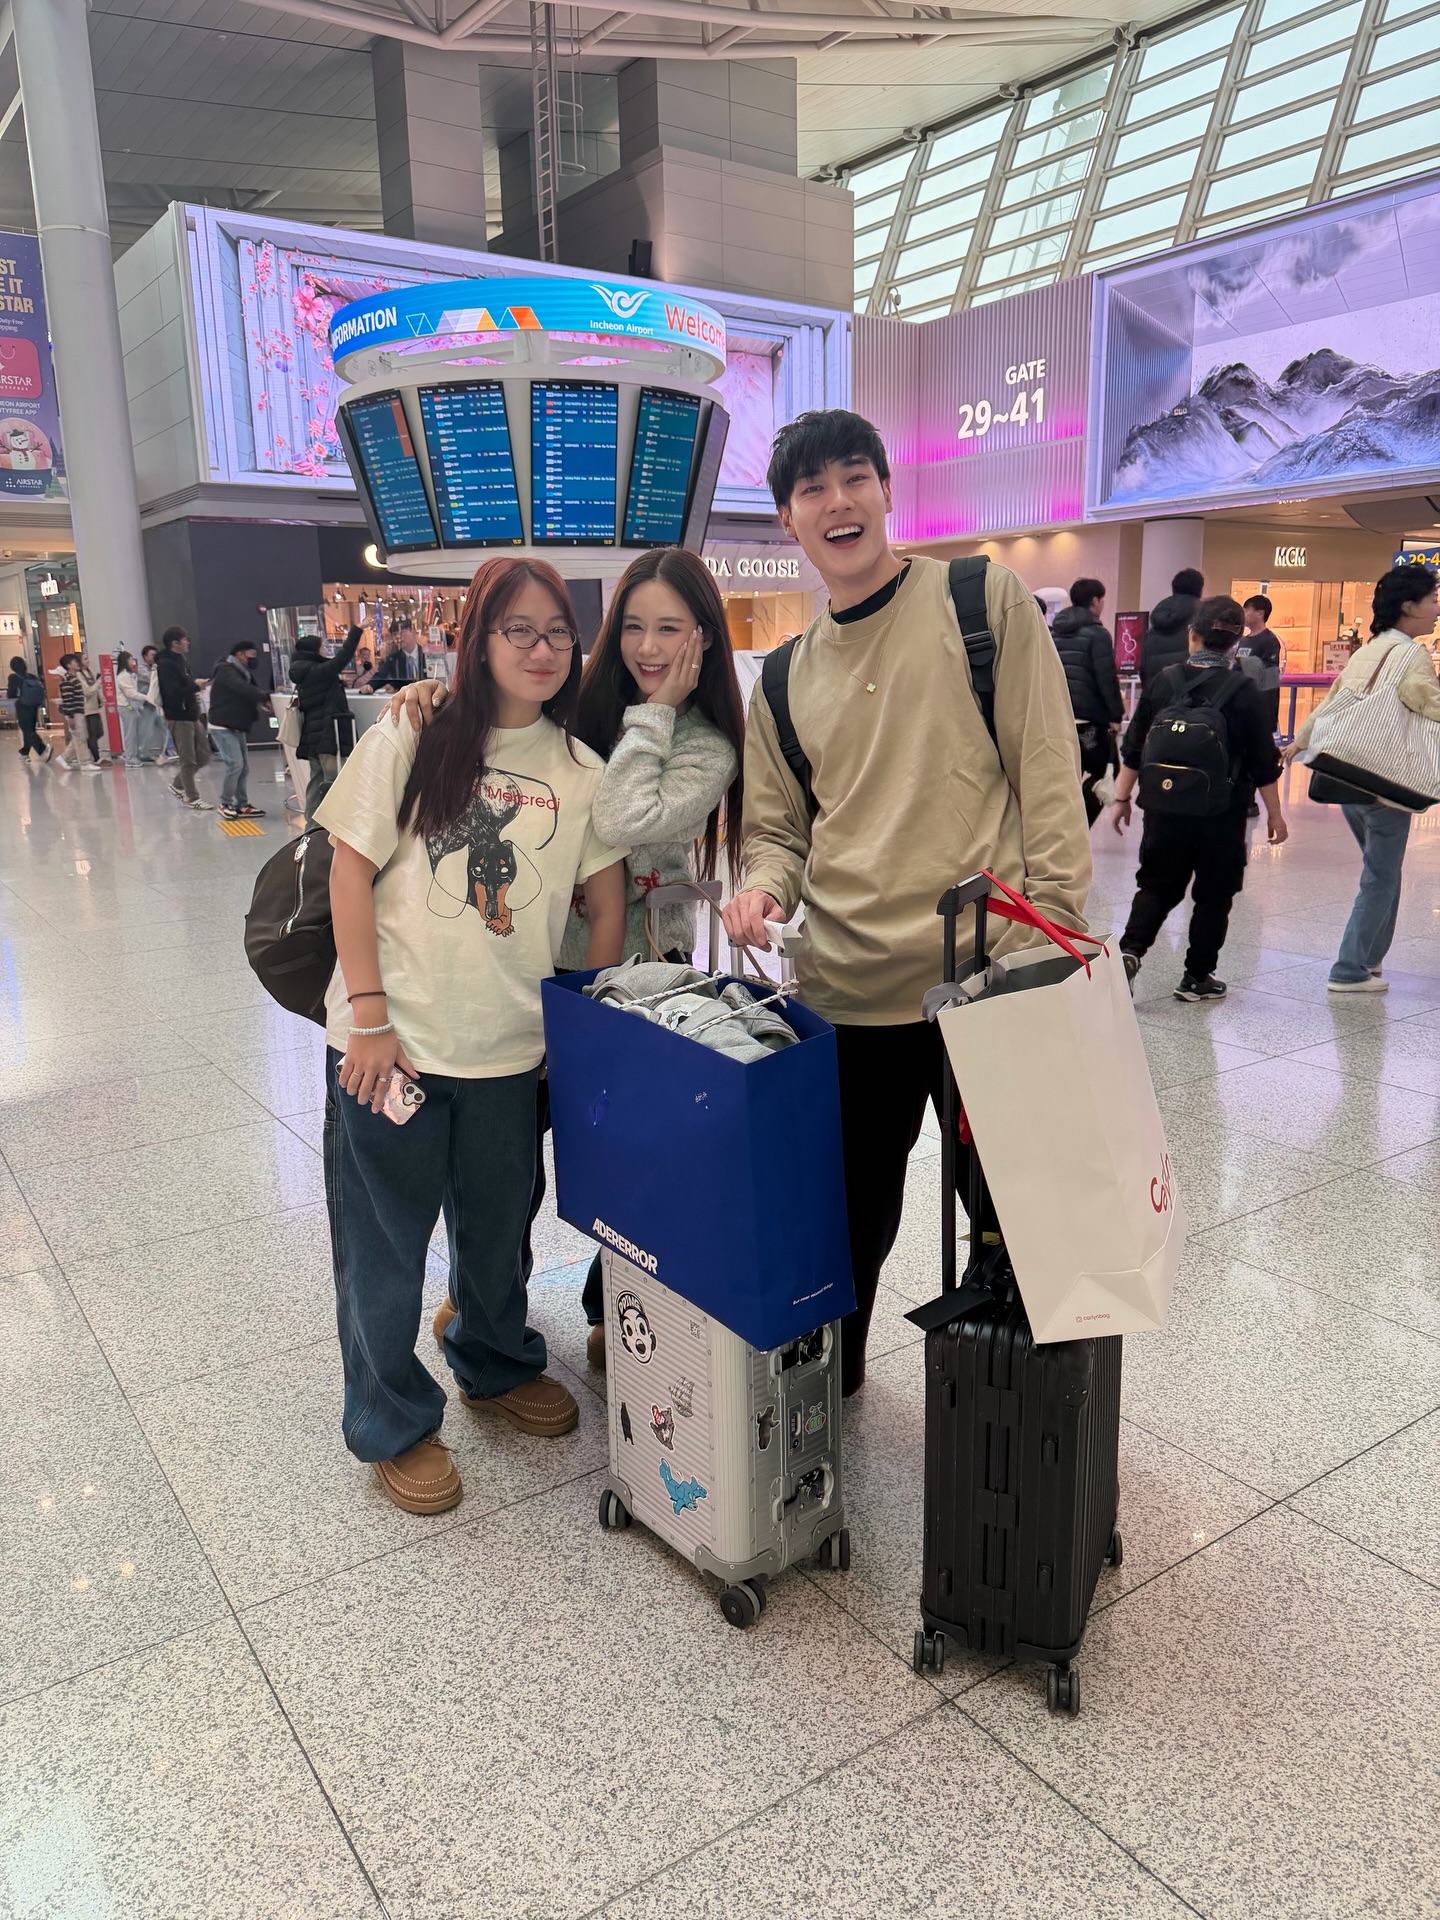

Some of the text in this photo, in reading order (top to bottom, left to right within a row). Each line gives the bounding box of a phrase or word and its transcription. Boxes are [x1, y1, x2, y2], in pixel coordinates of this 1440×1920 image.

[8, 277, 24, 295] IT
[589, 319, 655, 336] Incheon Airport
[1005, 358, 1046, 386] GATE
[15, 400, 41, 410] AIRPORT
[957, 387, 1045, 440] 29~41
[16, 478, 43, 487] AIRSTAR
[1274, 546, 1307, 567] MCM
[737, 557, 800, 578] GOOSE
[487, 785, 561, 812] Mercredi
[592, 1217, 658, 1275] ADERERROR
